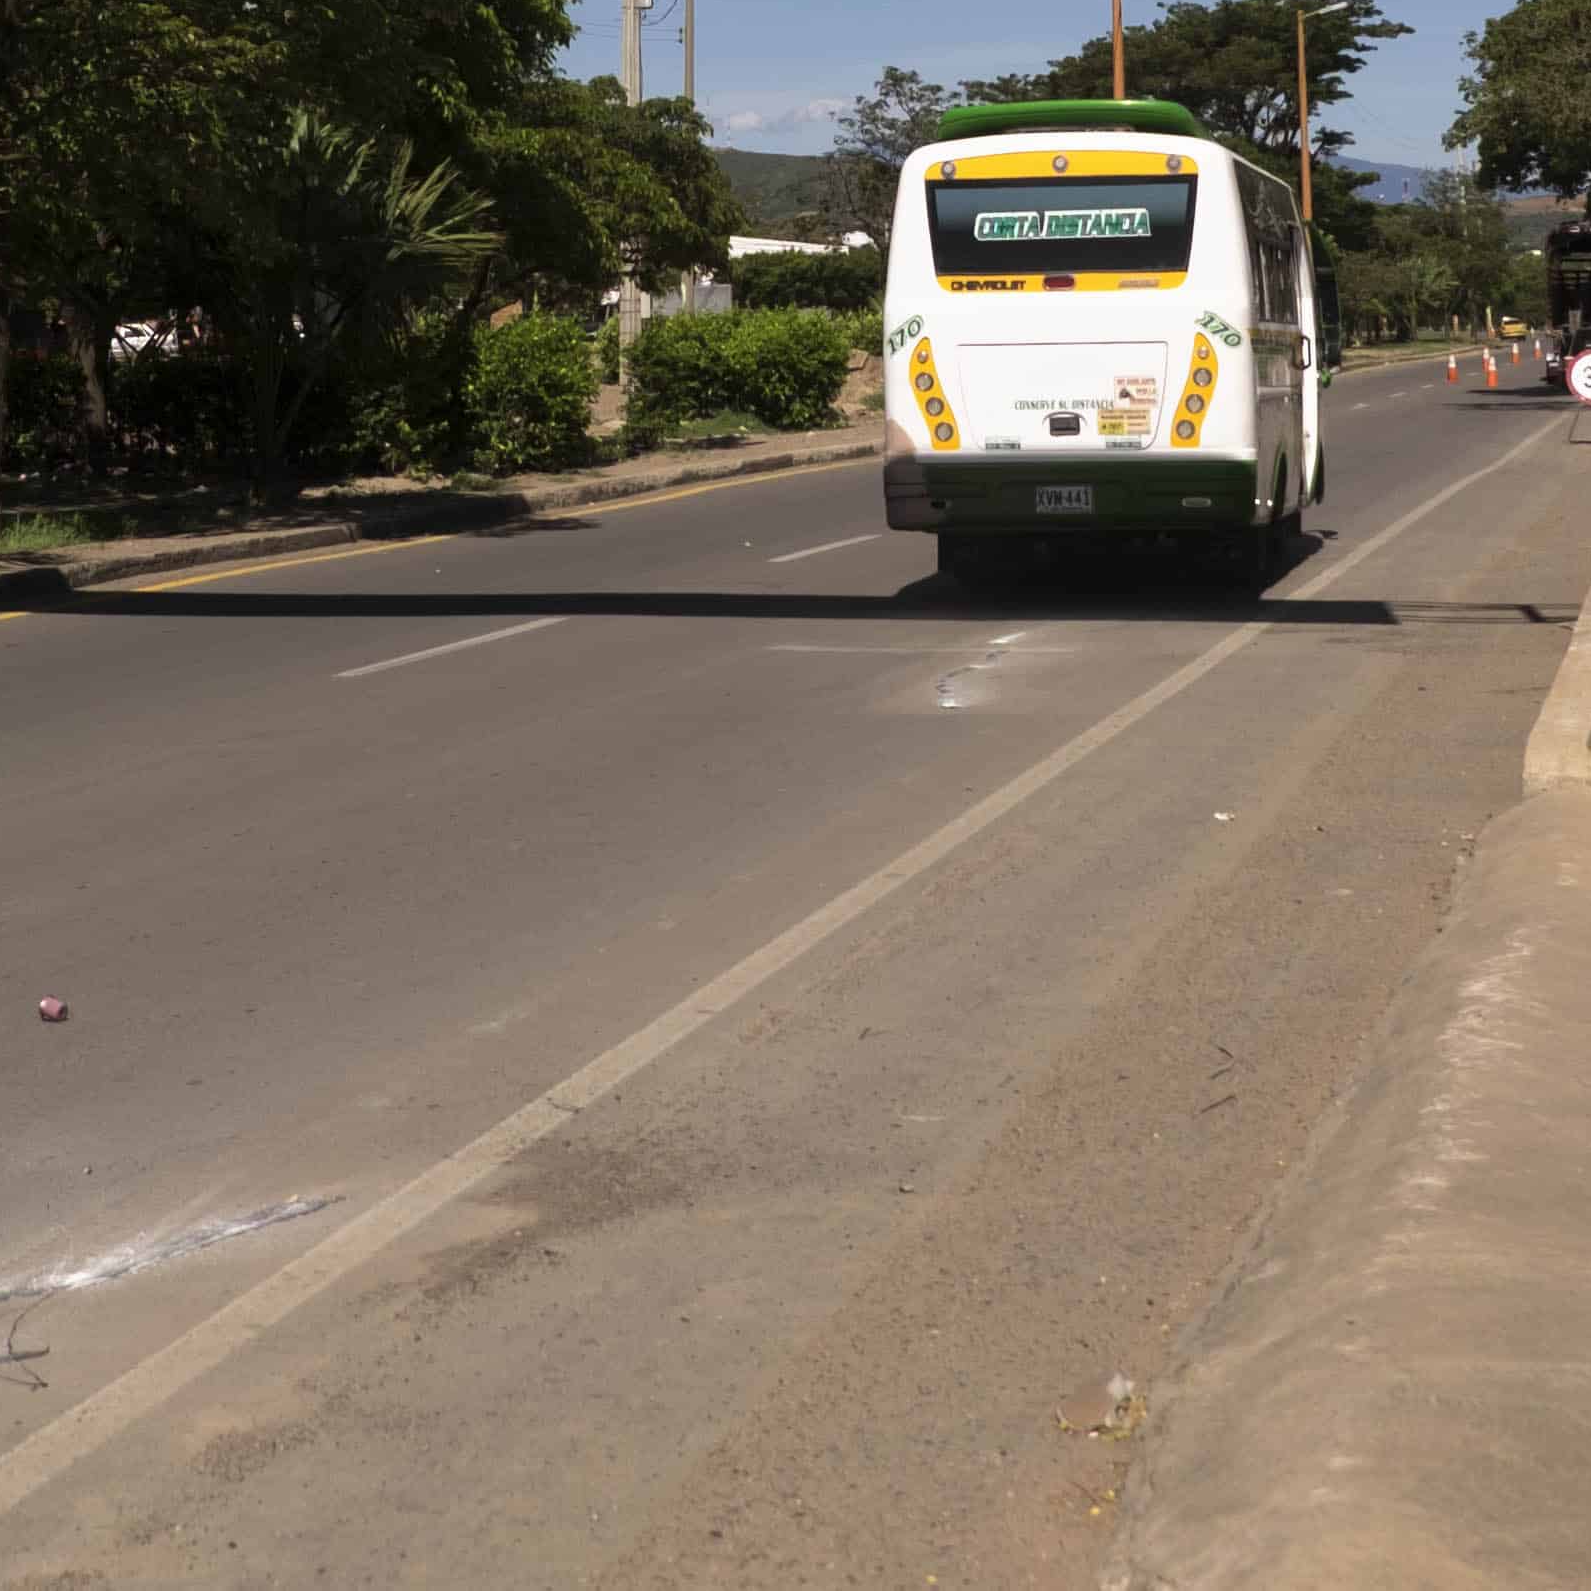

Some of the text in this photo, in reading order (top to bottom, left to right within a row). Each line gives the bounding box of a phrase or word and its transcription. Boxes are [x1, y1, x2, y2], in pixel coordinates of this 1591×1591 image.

[977, 211, 1150, 240] CORTA DISTANCIA
[951, 280, 1026, 290] CHEVROLET
